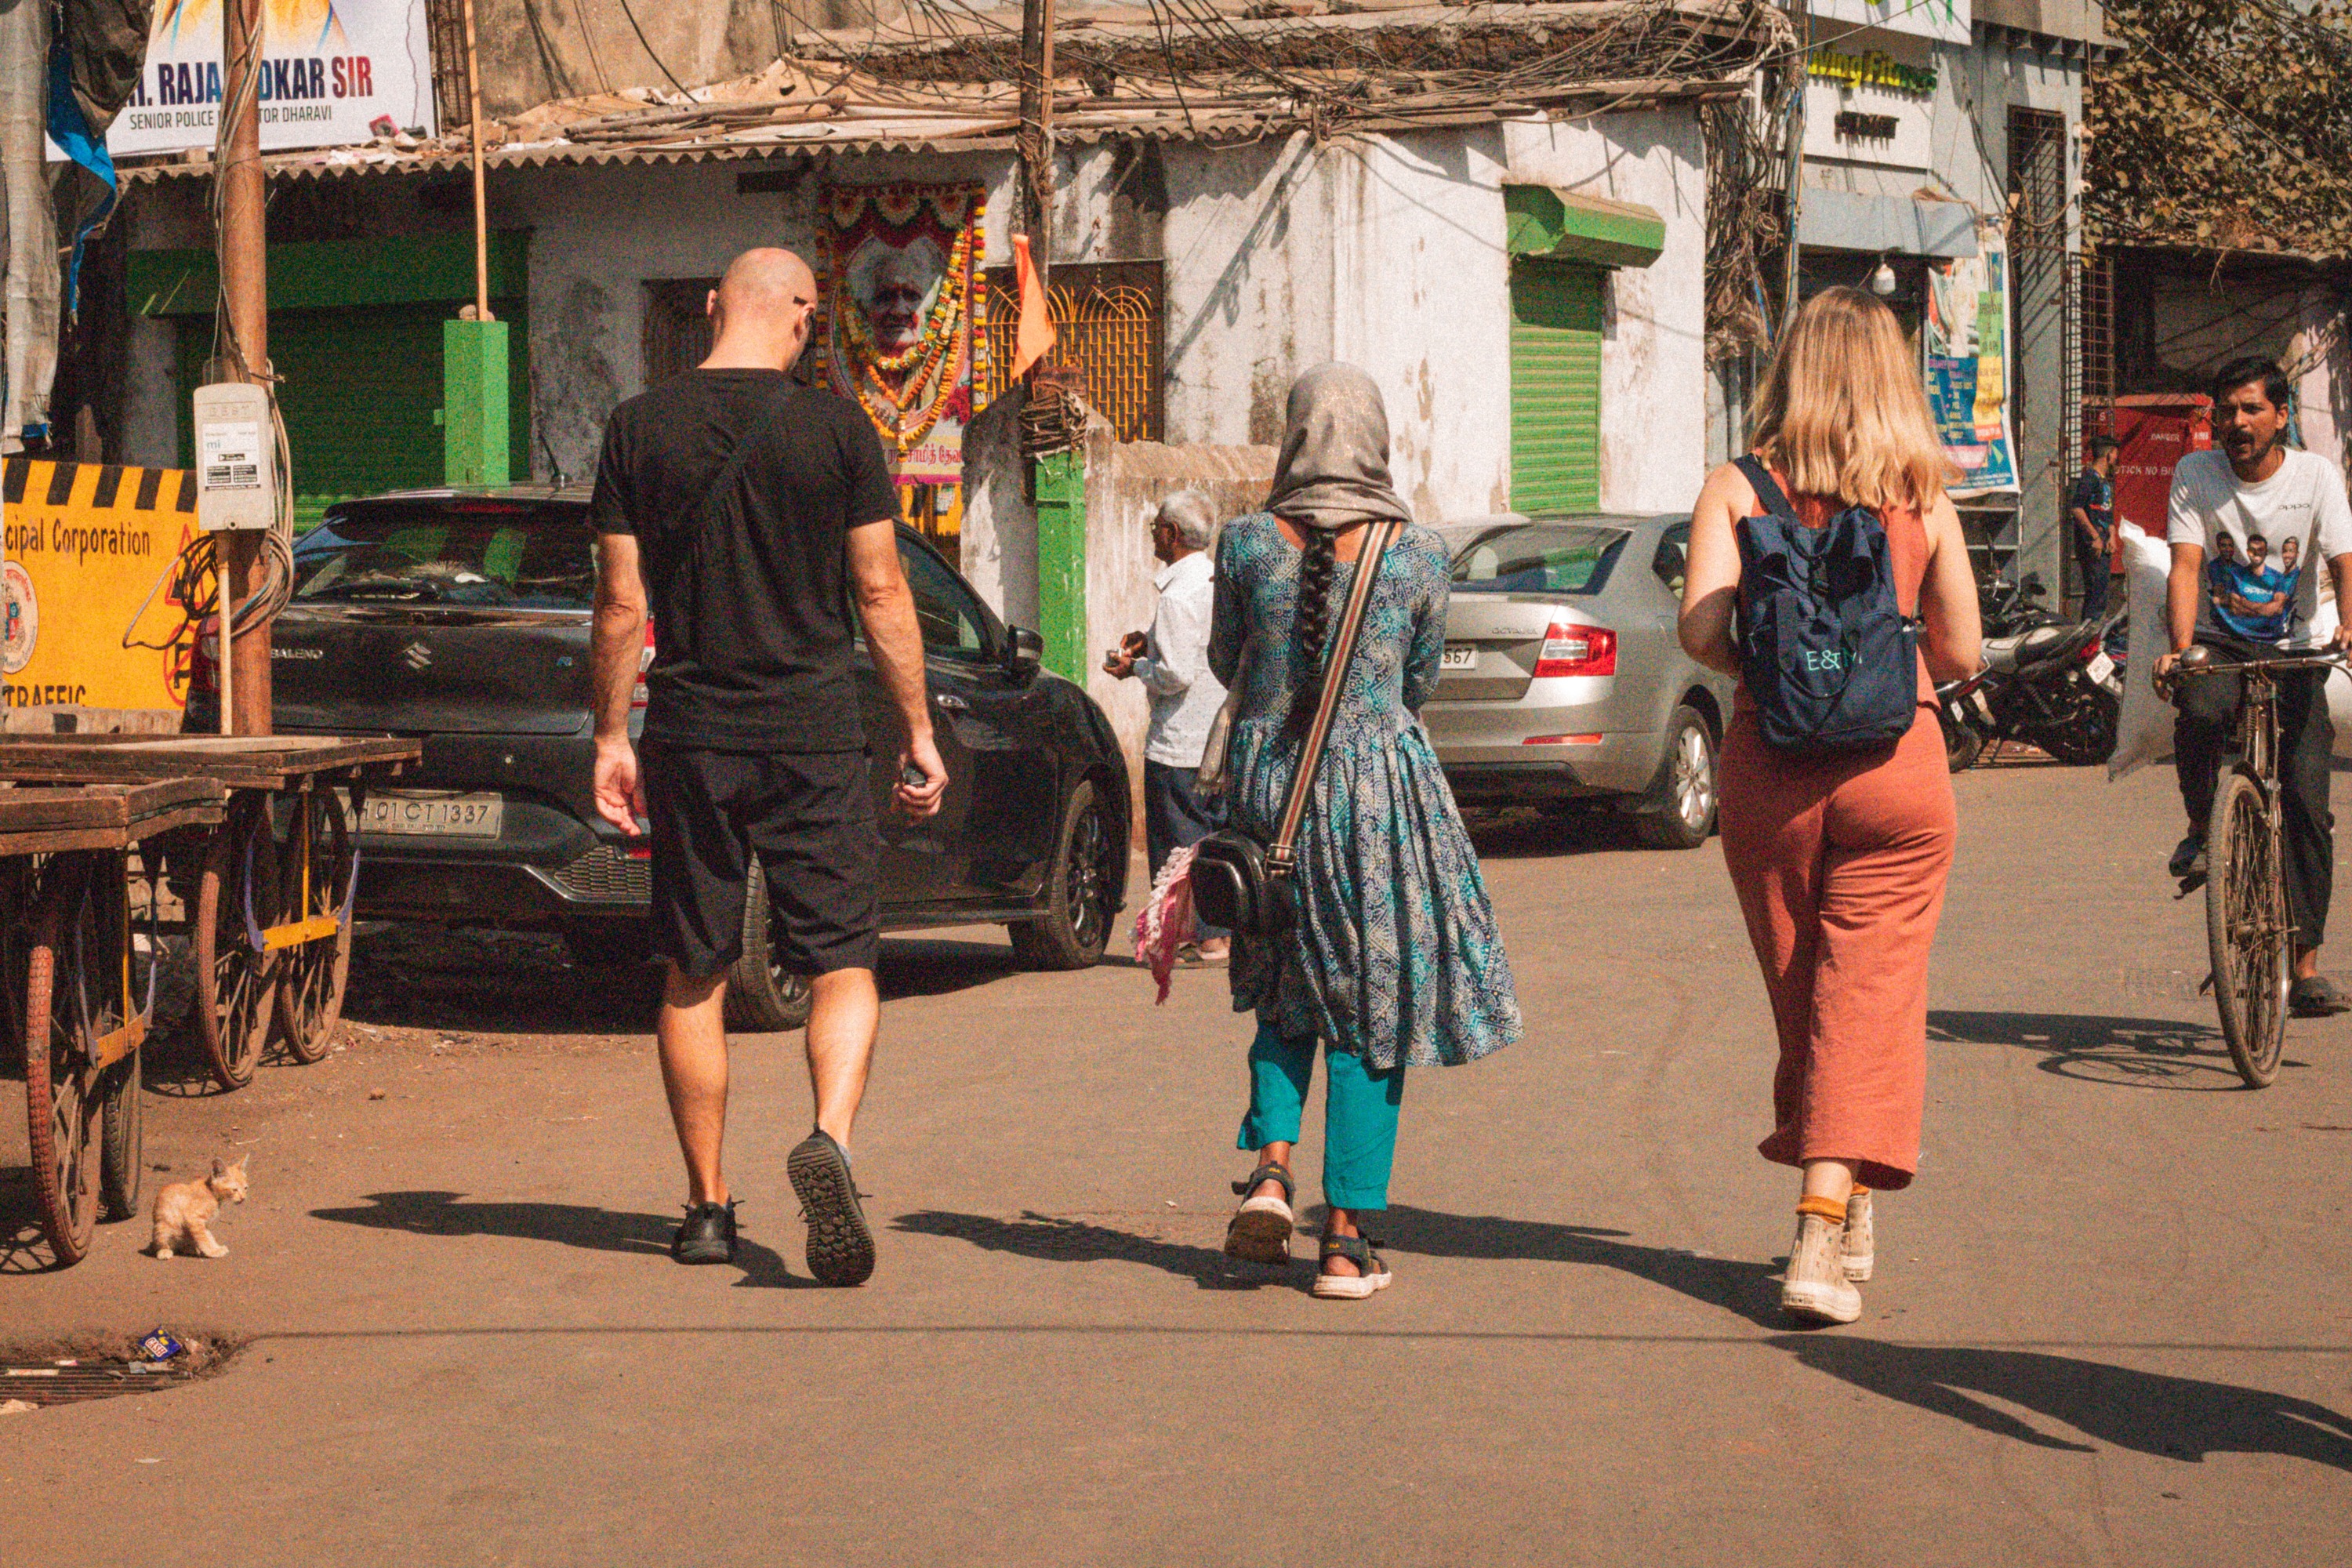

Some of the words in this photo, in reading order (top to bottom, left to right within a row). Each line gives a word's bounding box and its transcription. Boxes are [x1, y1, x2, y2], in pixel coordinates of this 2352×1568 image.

[331, 56, 373, 99] SIR
[129, 113, 172, 130] SENIOR
[176, 110, 214, 128] POLICE
[282, 105, 332, 123] DHARAVI
[2145, 466, 2157, 476] NO
[2278, 503, 2310, 511] oppo
[53, 518, 150, 567] Corporation
[270, 648, 323, 659] BALENO
[2, 684, 86, 707] TRAFFIC
[376, 801, 397, 821] 01
[405, 803, 434, 822] CT
[442, 804, 491, 824] 1337
[147, 1338, 166, 1356] CASH
